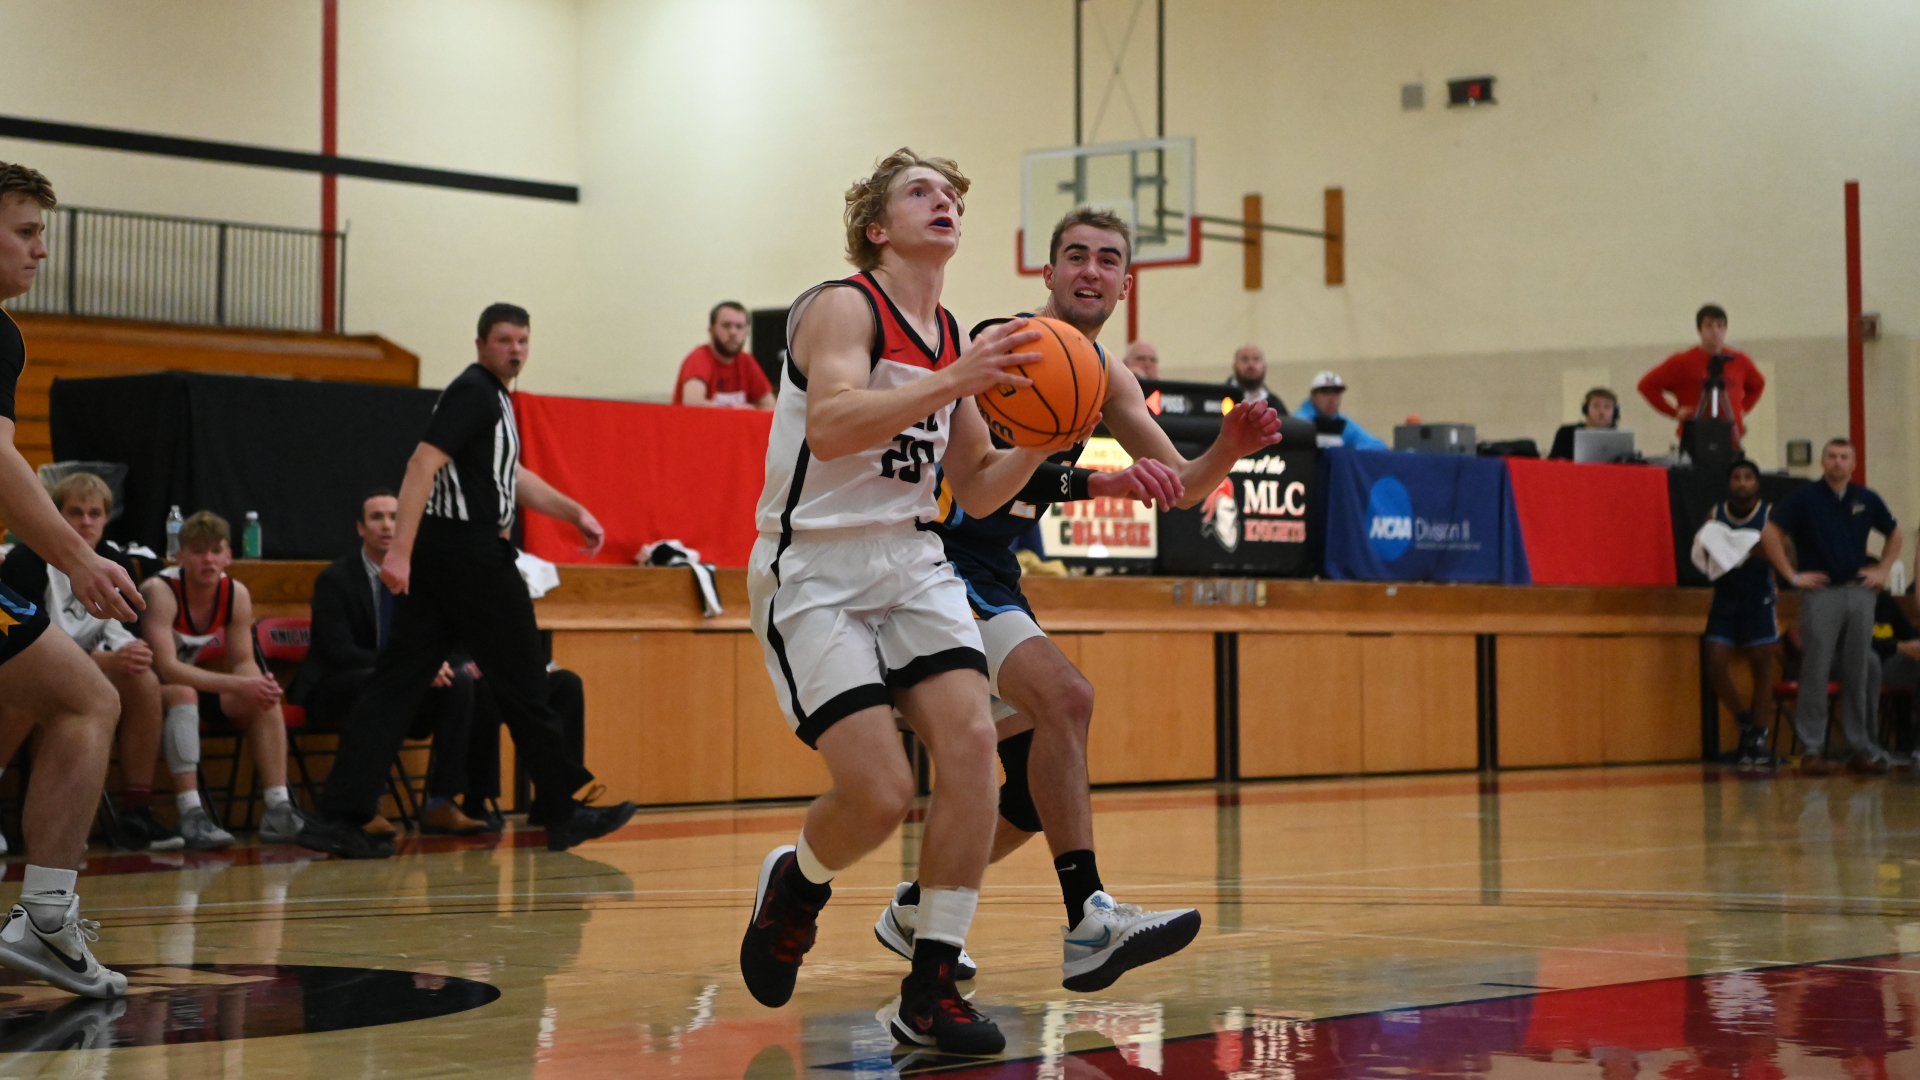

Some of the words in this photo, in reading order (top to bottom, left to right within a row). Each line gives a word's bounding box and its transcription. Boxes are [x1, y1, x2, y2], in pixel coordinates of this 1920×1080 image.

[1230, 459, 1255, 474] ome
[1267, 454, 1286, 475] the
[1243, 479, 1306, 517] MLC
[1061, 521, 1150, 546] COLLEGE
[1370, 516, 1411, 540] NCAA
[270, 628, 309, 644] KNIGH
